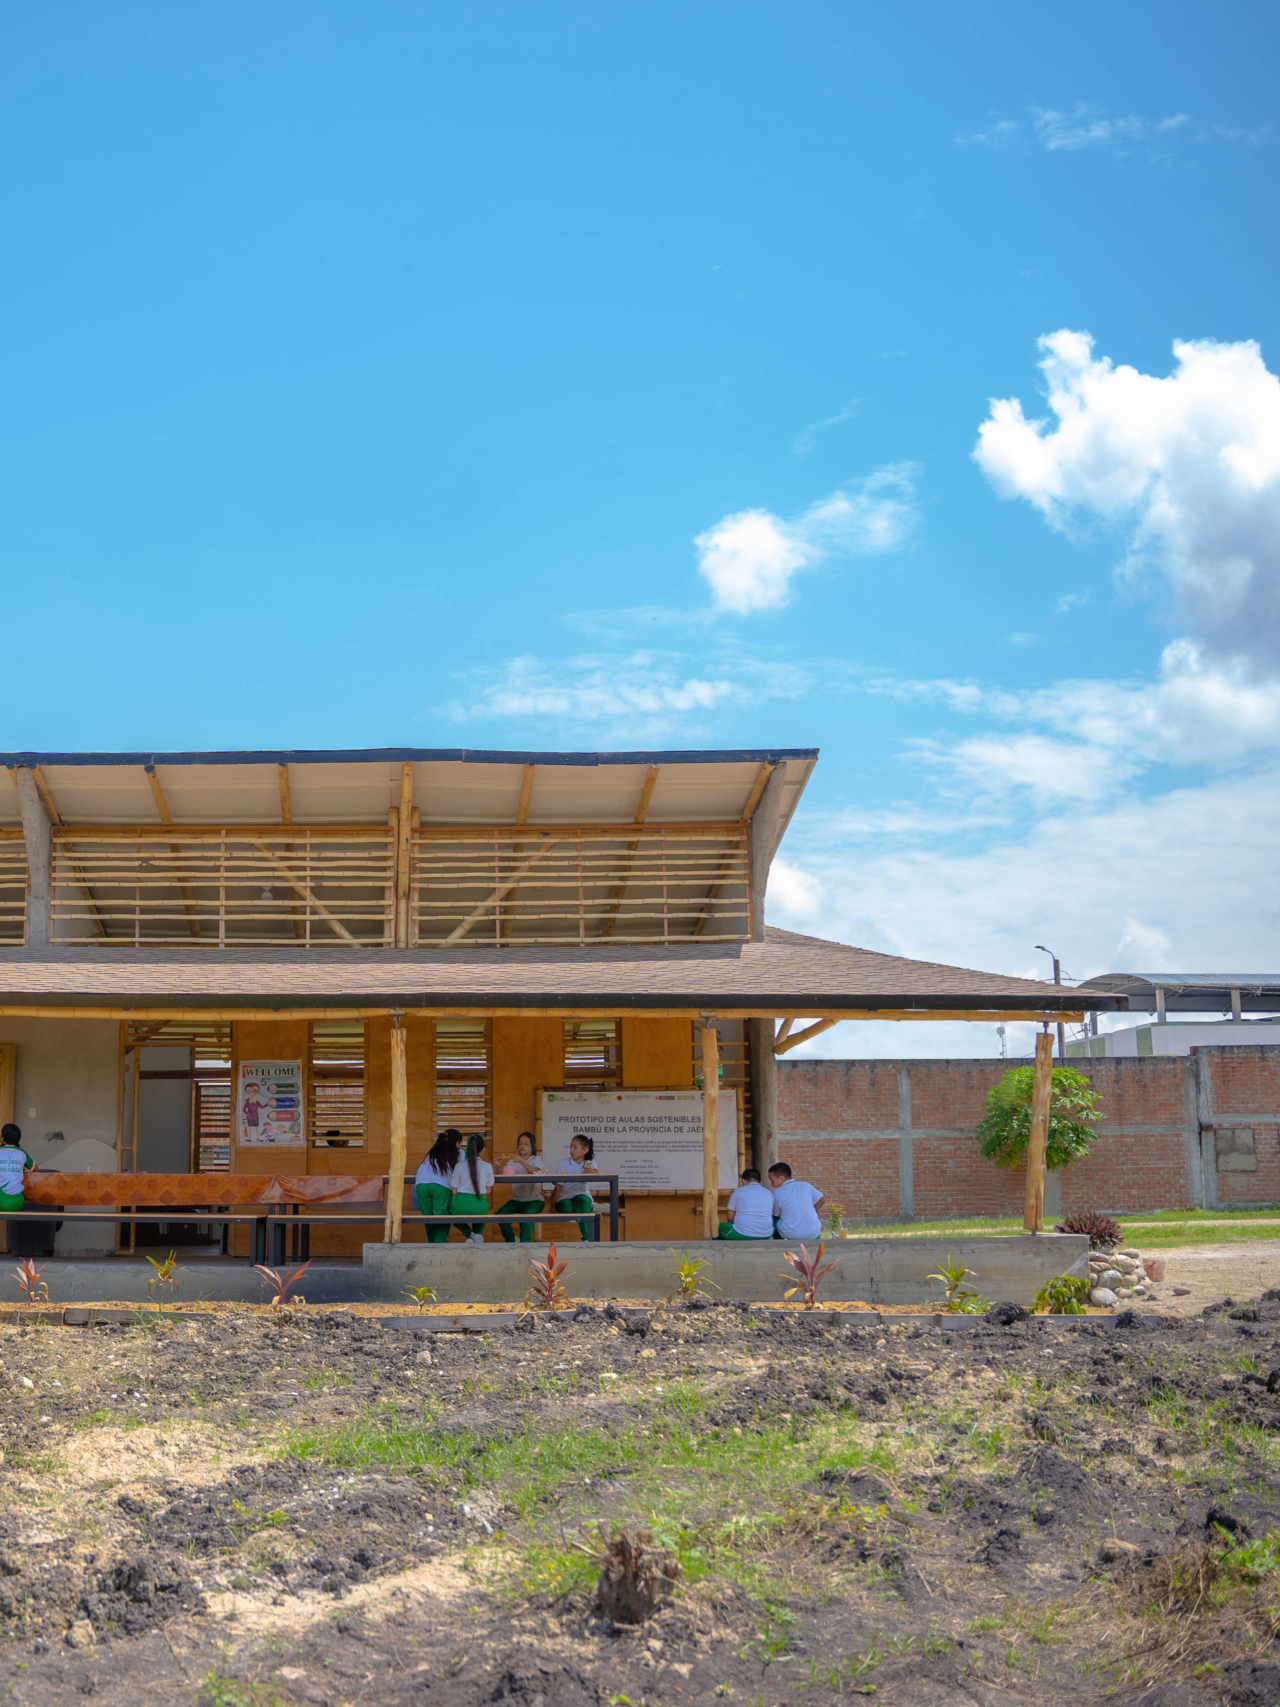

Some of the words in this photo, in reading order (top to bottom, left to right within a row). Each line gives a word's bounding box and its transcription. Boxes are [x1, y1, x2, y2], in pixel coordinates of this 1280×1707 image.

[245, 1067, 297, 1076] WELCOME
[558, 1115, 605, 1124] PROTOTIPO
[647, 1115, 702, 1123] SOSTENIBLES
[573, 1124, 602, 1134] BAMBÚ
[629, 1125, 672, 1133] PROVINCIA
